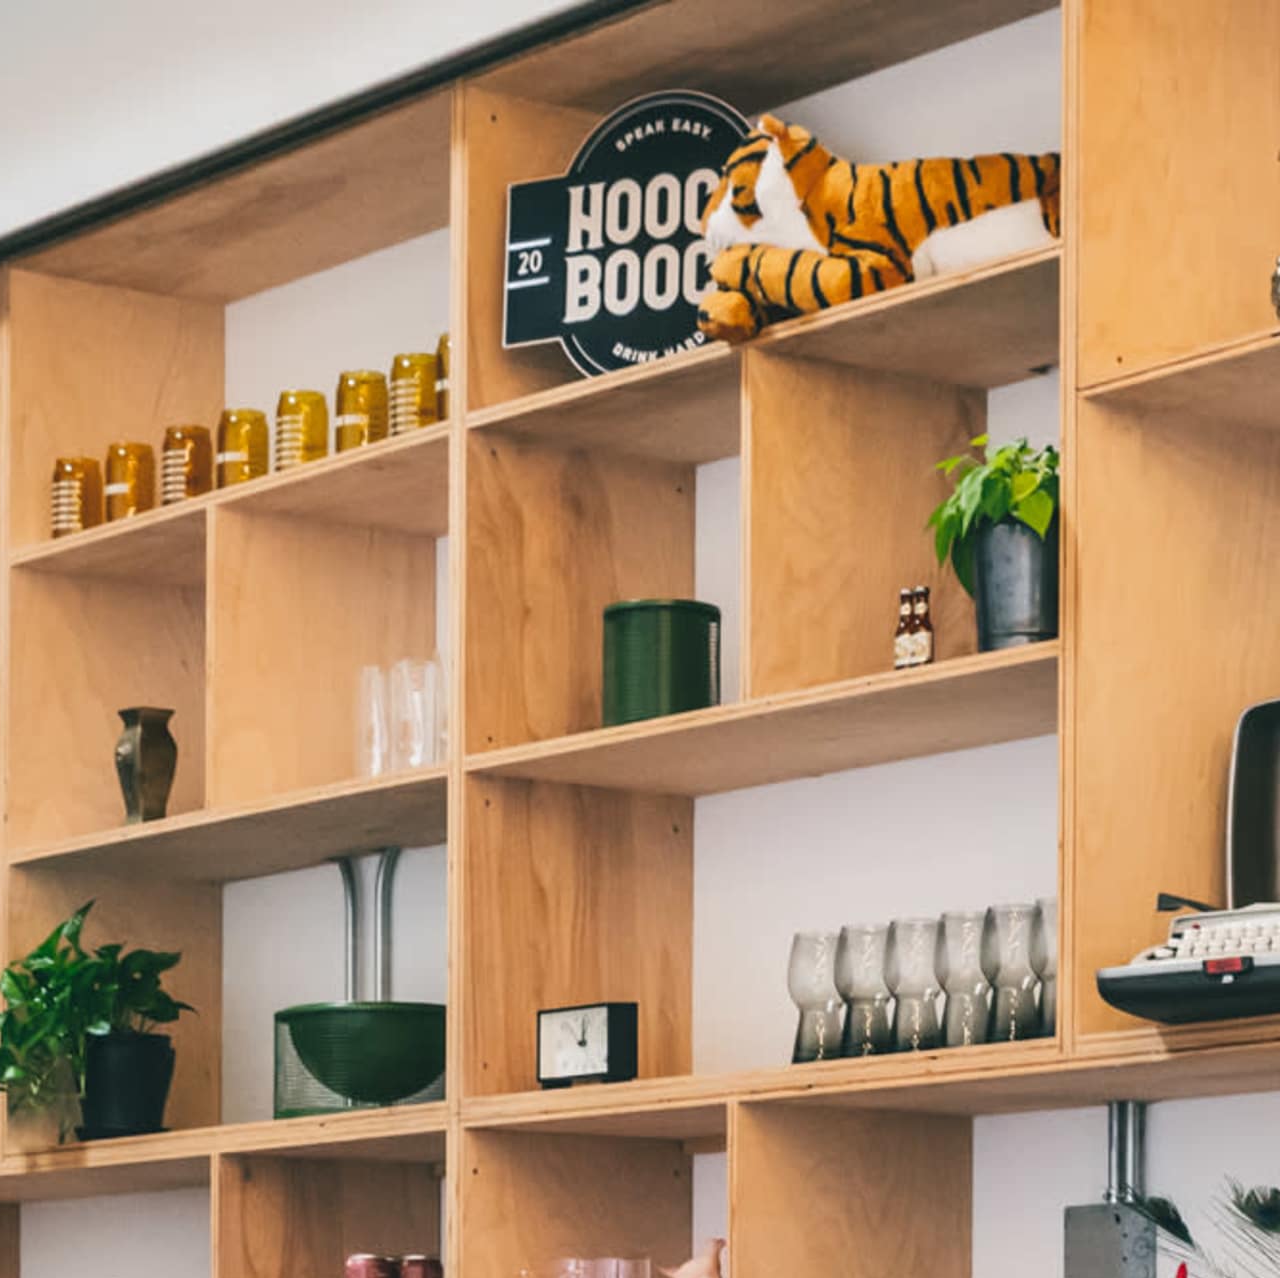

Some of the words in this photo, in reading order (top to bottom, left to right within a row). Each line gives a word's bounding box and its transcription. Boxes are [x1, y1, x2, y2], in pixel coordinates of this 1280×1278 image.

[615, 120, 665, 152] SPEAK
[566, 168, 720, 252] HOOC
[518, 250, 543, 275] 20
[562, 240, 718, 323] BOOC
[612, 342, 657, 363] DRINK
